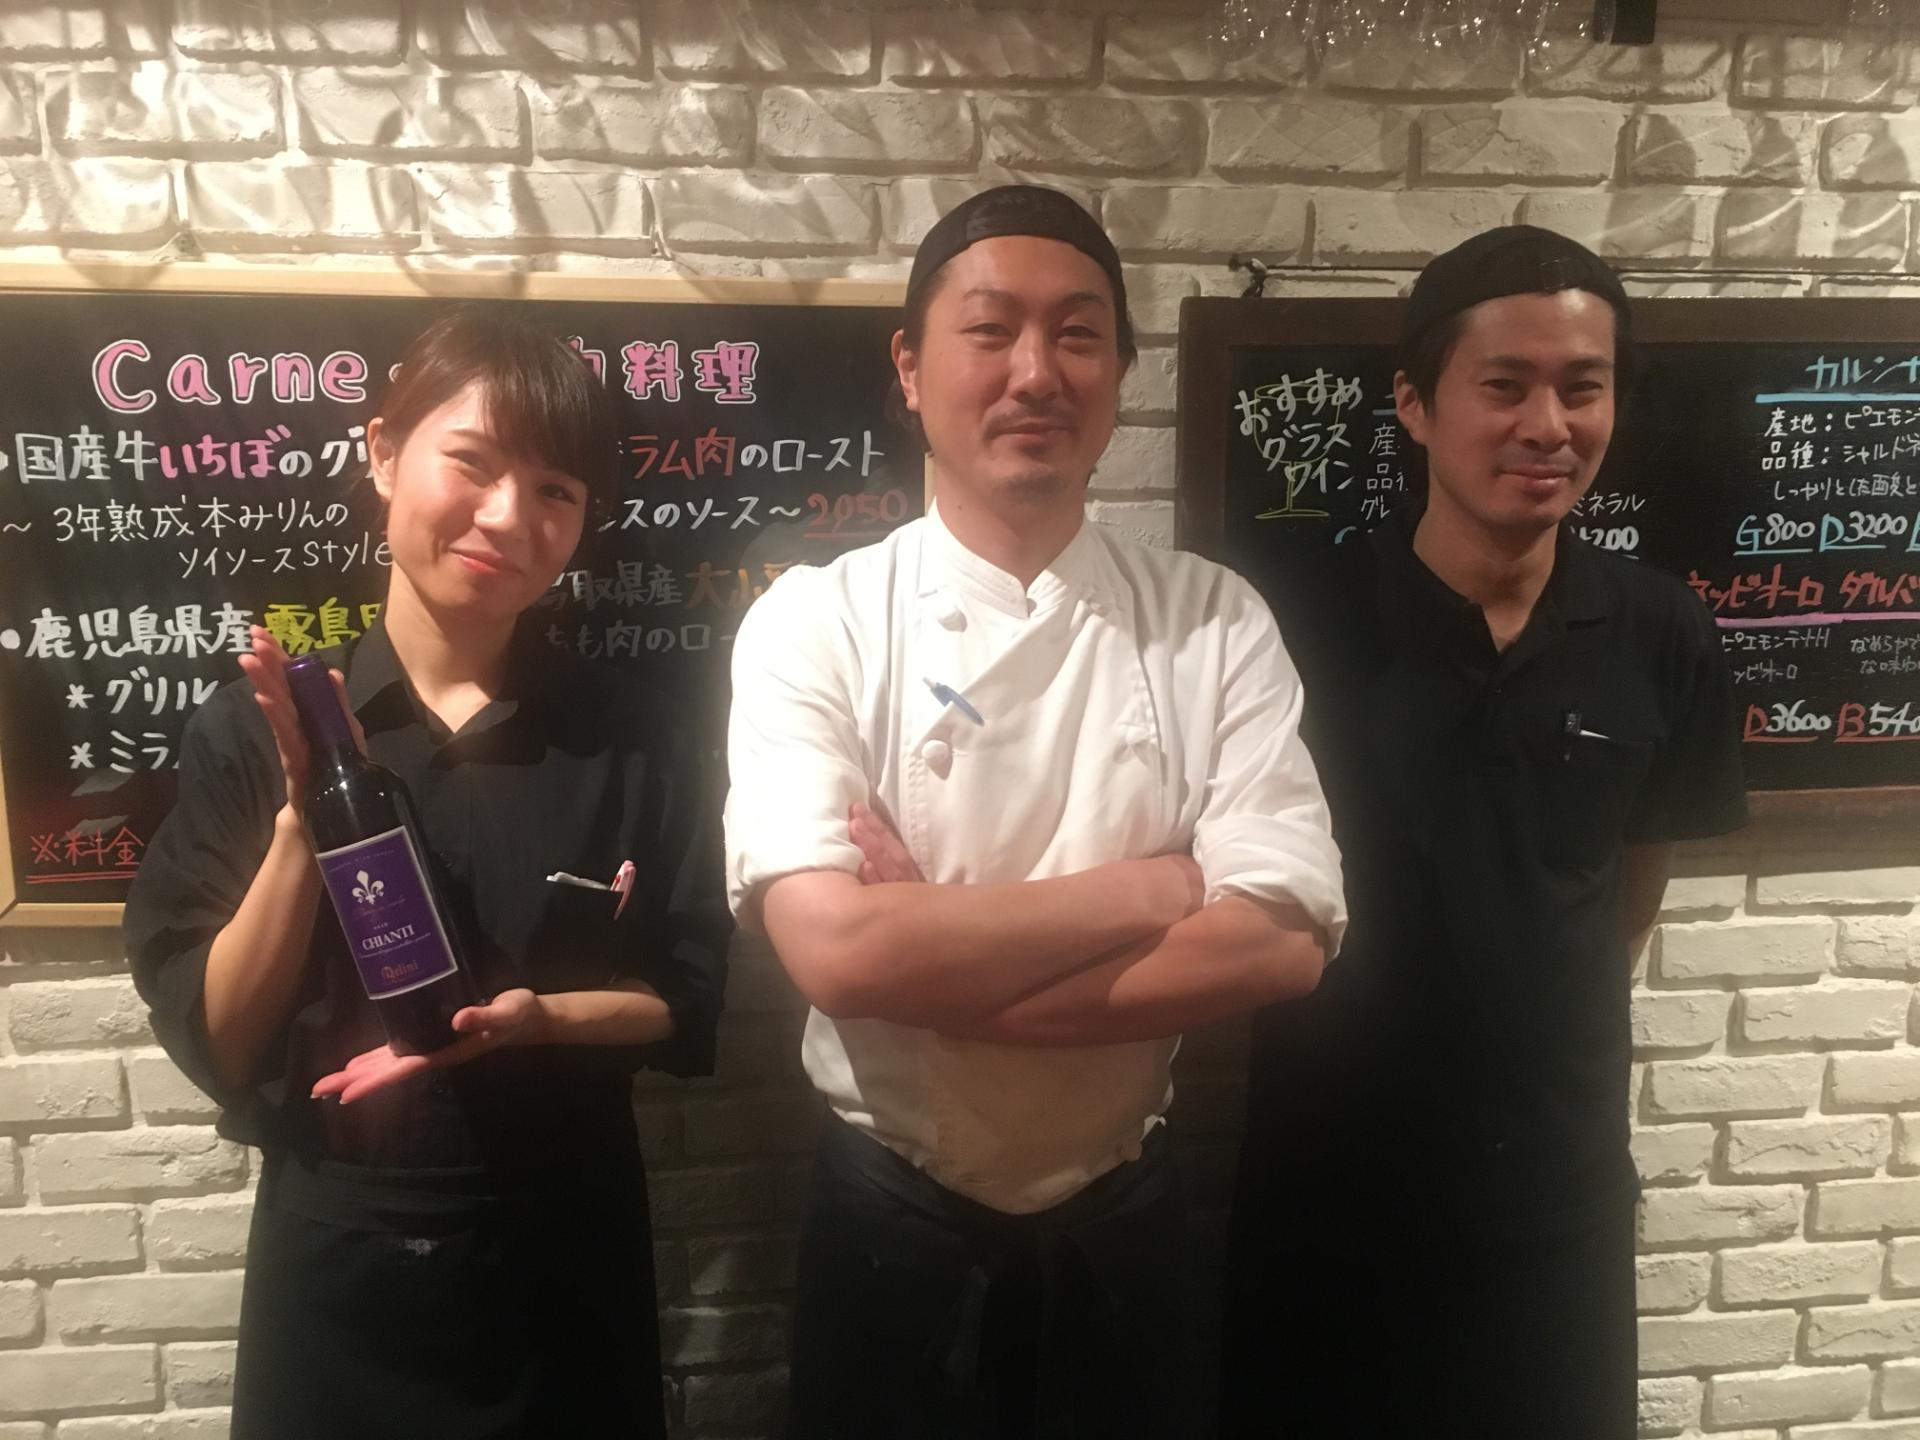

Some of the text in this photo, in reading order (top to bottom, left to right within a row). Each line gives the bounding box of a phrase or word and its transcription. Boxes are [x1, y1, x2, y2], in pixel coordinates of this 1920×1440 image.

[92, 339, 368, 413] Carne
[1234, 367, 1363, 436] おすすめ
[627, 427, 885, 480] ラム肉のロースト
[1263, 423, 1351, 472] グラス
[1284, 457, 1355, 497] ワイン
[361, 924, 415, 951] CHIANTI
